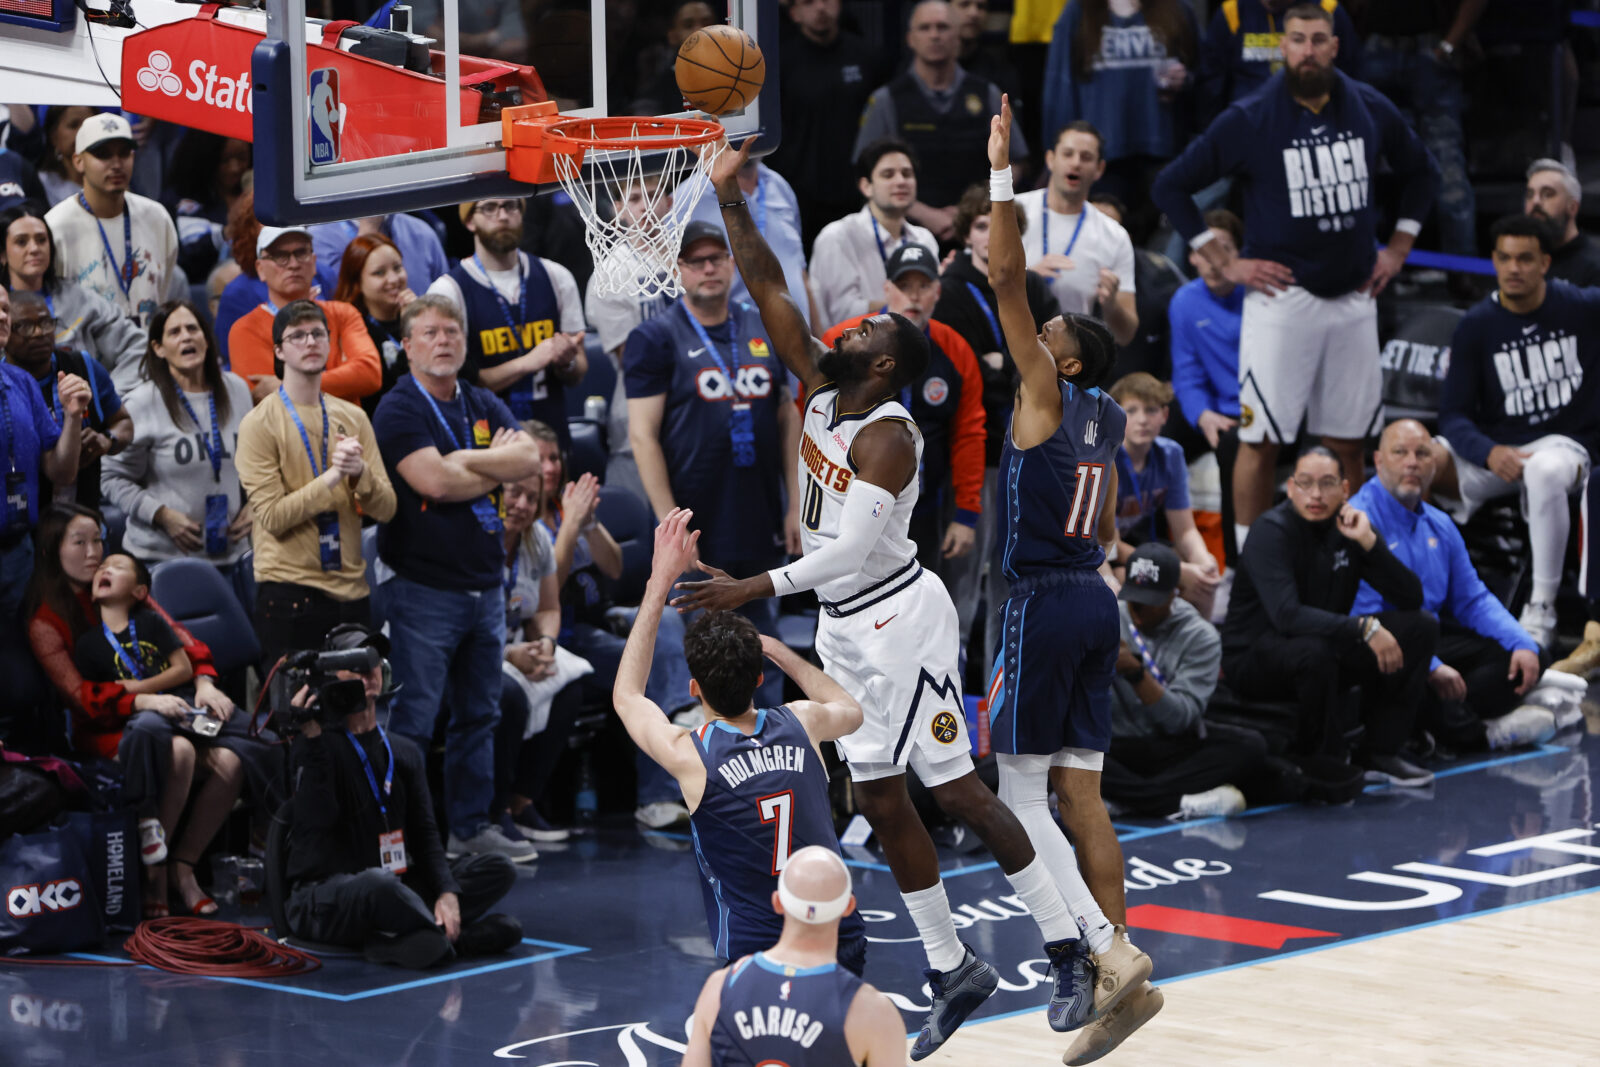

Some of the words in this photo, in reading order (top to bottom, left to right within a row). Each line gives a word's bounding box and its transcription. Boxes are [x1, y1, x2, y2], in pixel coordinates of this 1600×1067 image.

[314, 142, 330, 159] NBA
[1283, 137, 1368, 190] BLACK
[1289, 180, 1368, 218] HISTORY
[696, 365, 772, 401] OKC
[1493, 335, 1583, 394] BLACK
[1083, 419, 1098, 447] JOE
[800, 431, 854, 493] NUGGETS
[801, 472, 824, 532] 10
[1065, 462, 1106, 538] 11
[718, 745, 805, 789] HOLMGREN
[756, 789, 794, 876] 7
[105, 831, 124, 914] HOMELAND
[1257, 823, 1600, 911] ULT
[6, 878, 82, 918] OKC
[734, 1005, 823, 1049] CARUSO
